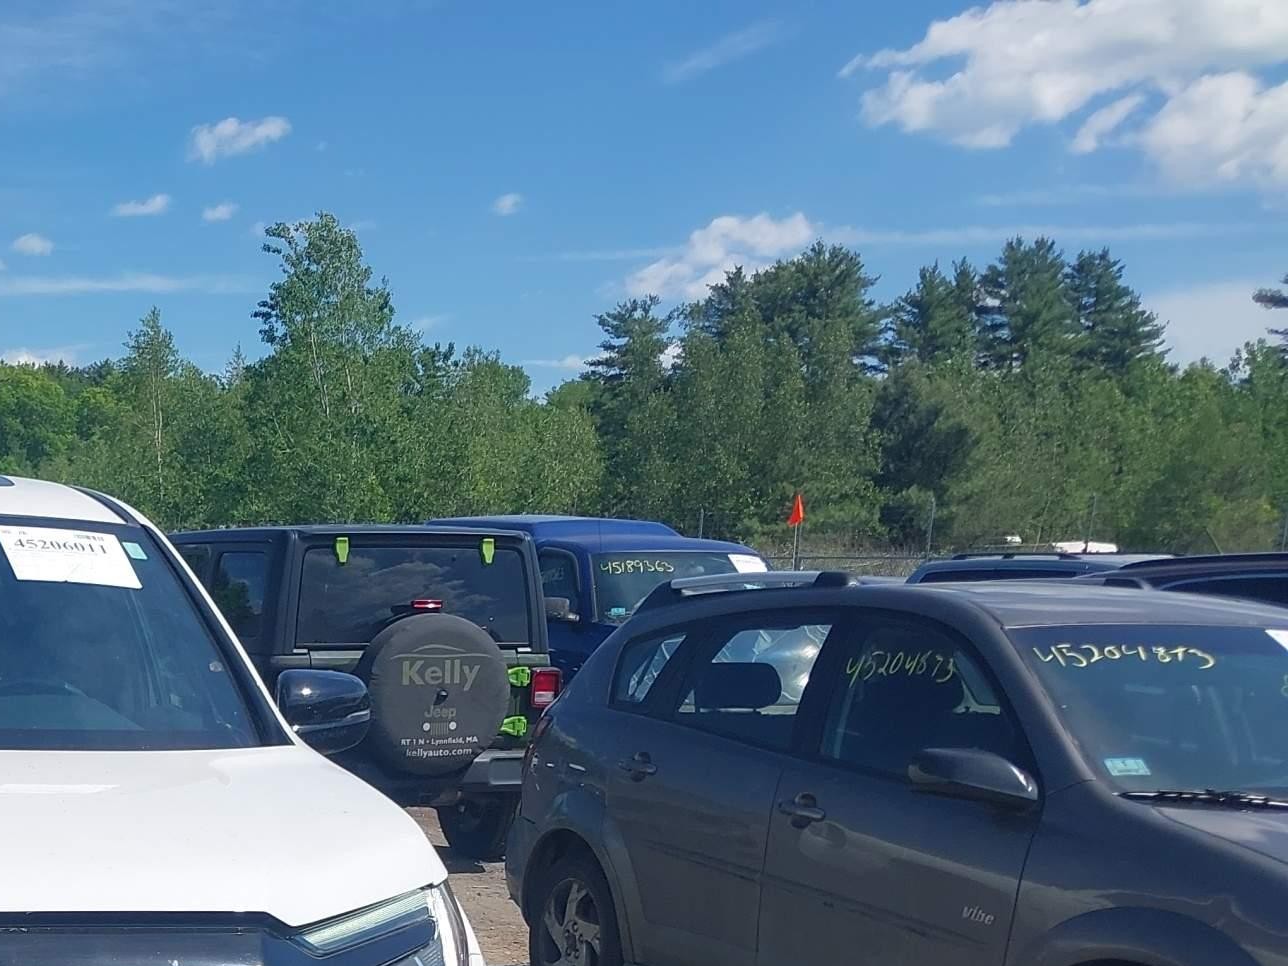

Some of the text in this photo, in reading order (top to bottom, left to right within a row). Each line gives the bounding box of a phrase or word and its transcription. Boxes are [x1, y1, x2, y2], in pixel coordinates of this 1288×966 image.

[14, 538, 107, 554] 45206011
[600, 560, 674, 574] 45189363
[1032, 643, 1215, 669] 45204873
[401, 659, 481, 692] Kelly
[846, 651, 958, 688] 45204873
[424, 705, 456, 719] Jeep
[466, 735, 479, 743] MA
[406, 747, 472, 758] kellyauto.com
